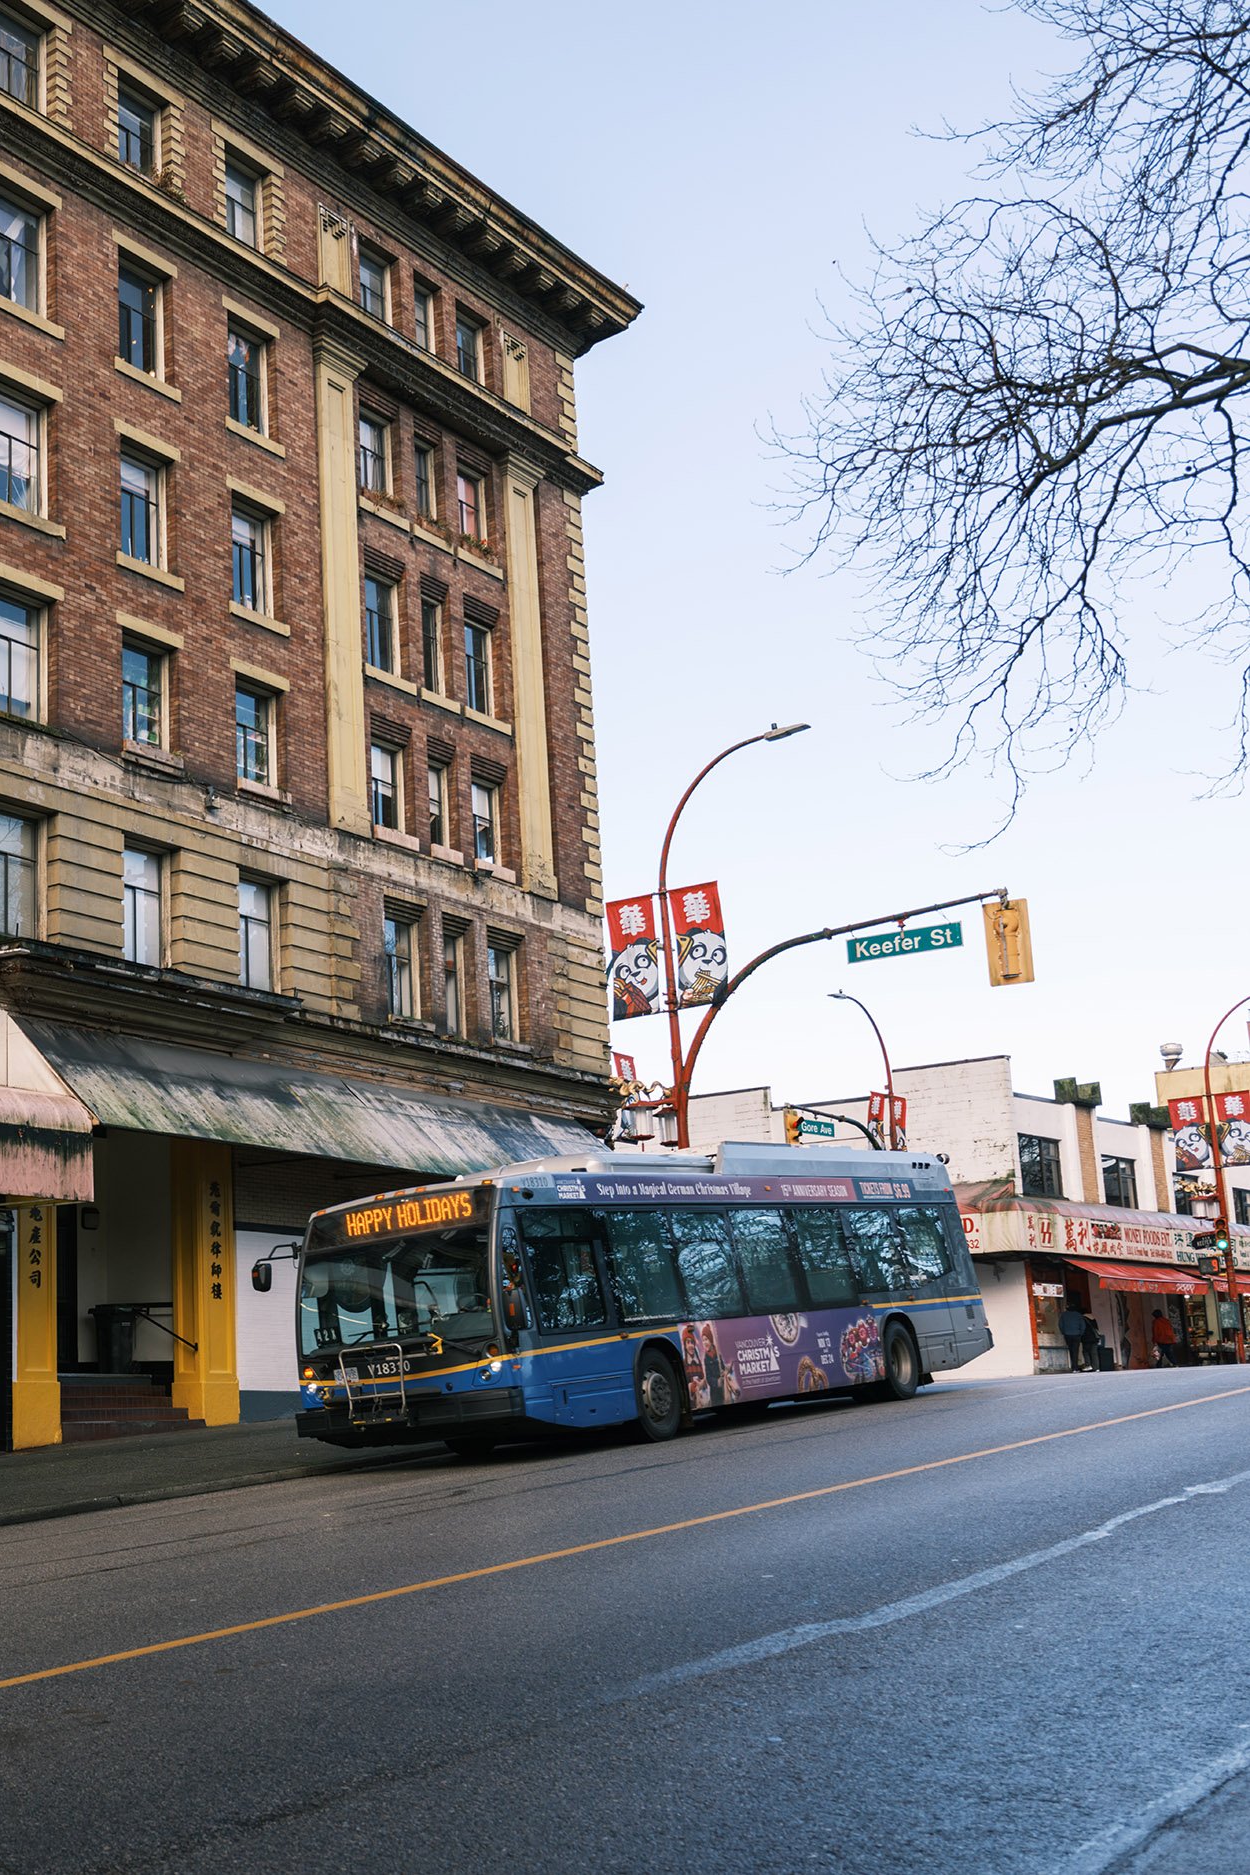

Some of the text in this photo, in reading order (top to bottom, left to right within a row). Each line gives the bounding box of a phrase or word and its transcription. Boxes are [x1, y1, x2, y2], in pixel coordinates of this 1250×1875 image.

[683, 890, 710, 924] 華
[619, 903, 646, 936] 華
[855, 929, 953, 959] Keefer St
[801, 1121, 832, 1135] Gore Ave
[558, 1192, 579, 1200] MARKET
[597, 1183, 614, 1198] Step
[617, 1183, 631, 1195] Into
[640, 1182, 667, 1198] Magical
[668, 1183, 695, 1196] German
[695, 1182, 728, 1195] Christmas
[729, 1182, 752, 1198] Village
[793, 1184, 828, 1197] ANNIVERSARY
[828, 1185, 848, 1197] SEASON
[346, 1193, 473, 1237] HAPPY HOLIDAYS
[734, 1337, 766, 1349] VANCOUVER
[739, 1359, 770, 1375] MARKET
